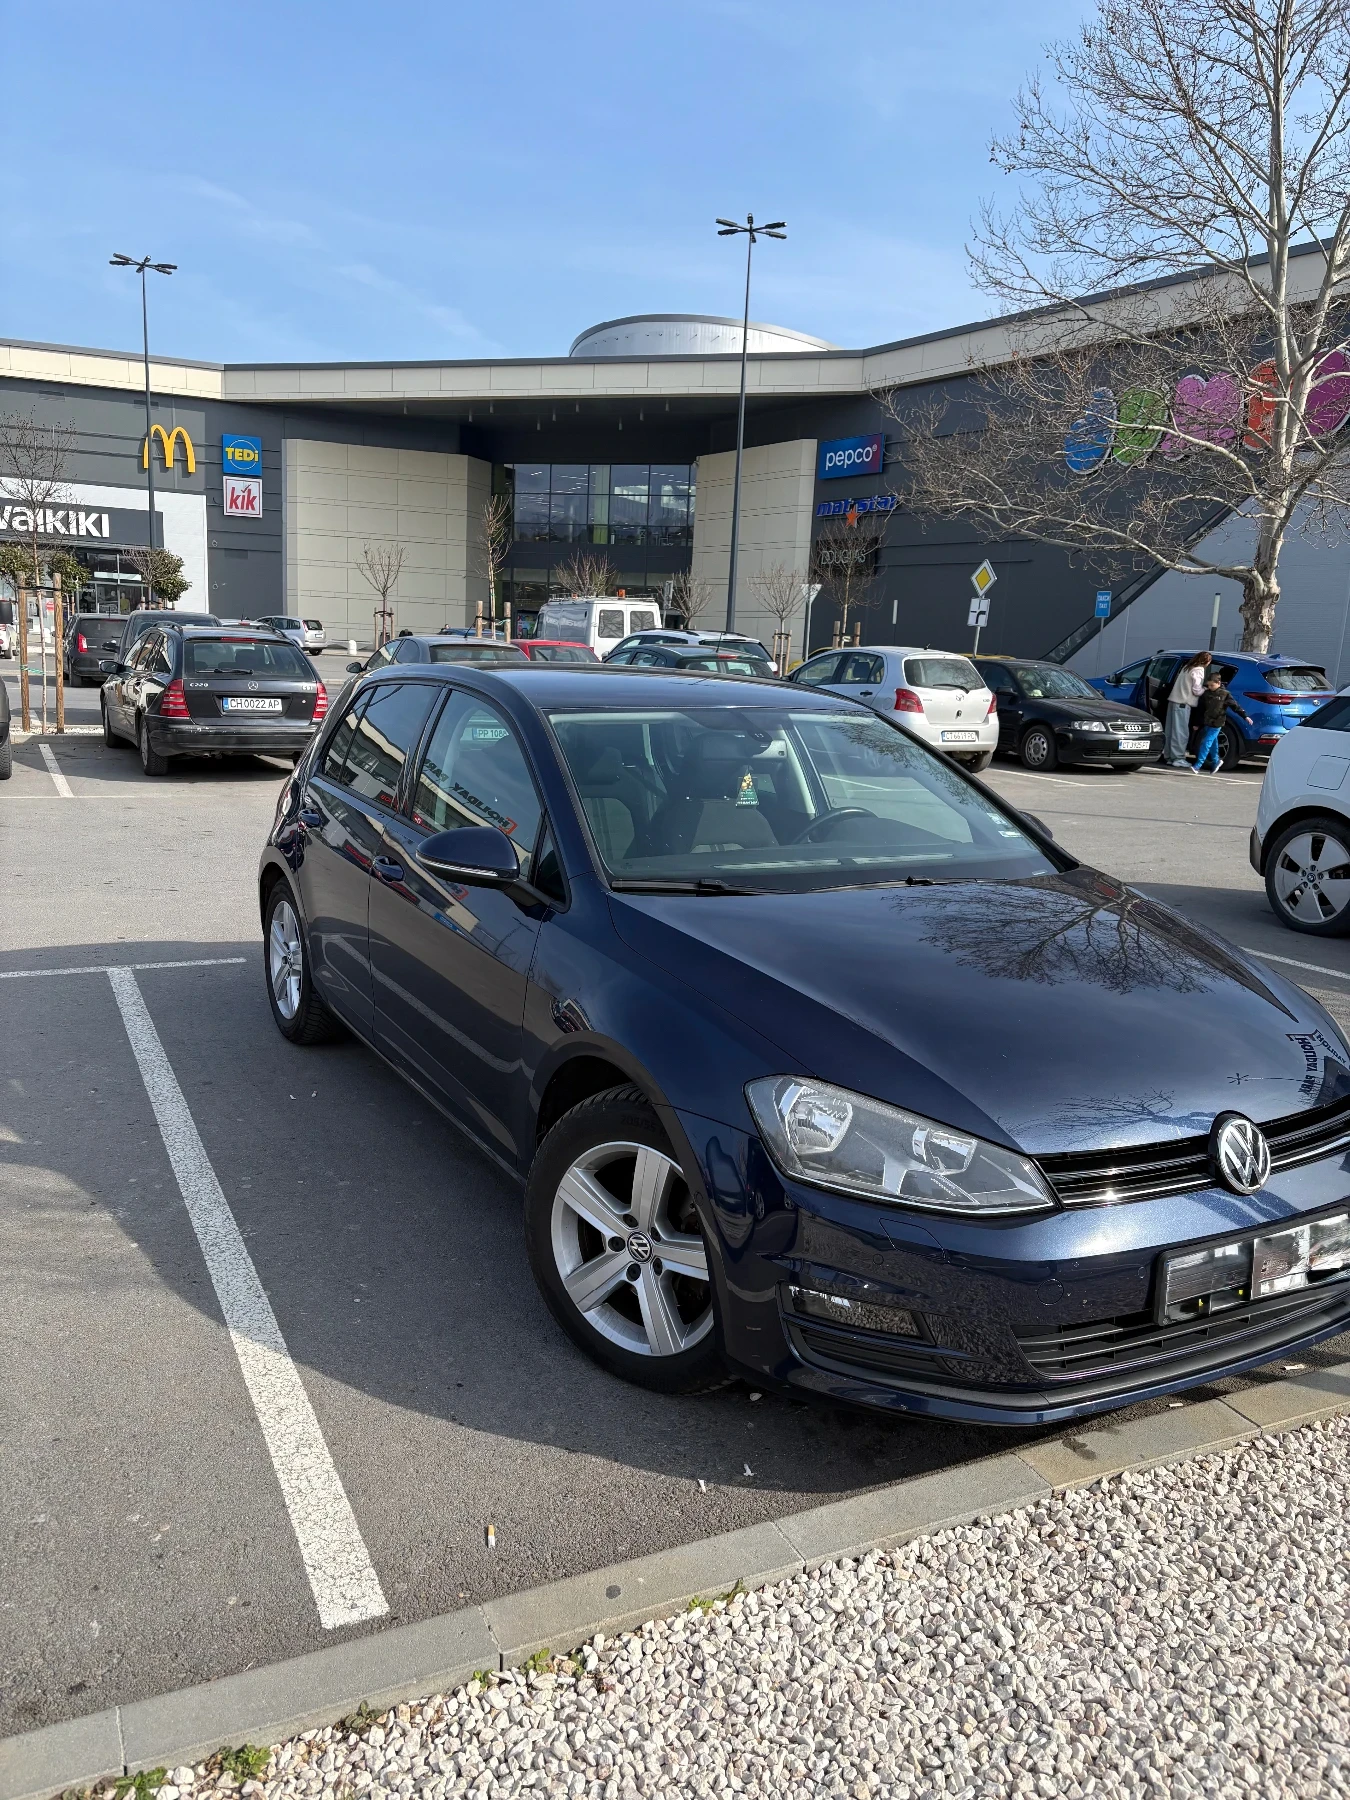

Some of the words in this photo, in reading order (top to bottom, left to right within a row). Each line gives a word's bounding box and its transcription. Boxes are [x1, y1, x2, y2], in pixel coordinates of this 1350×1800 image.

[225, 447, 259, 462] TEDi
[825, 446, 873, 471] pepco
[228, 483, 258, 511] kik
